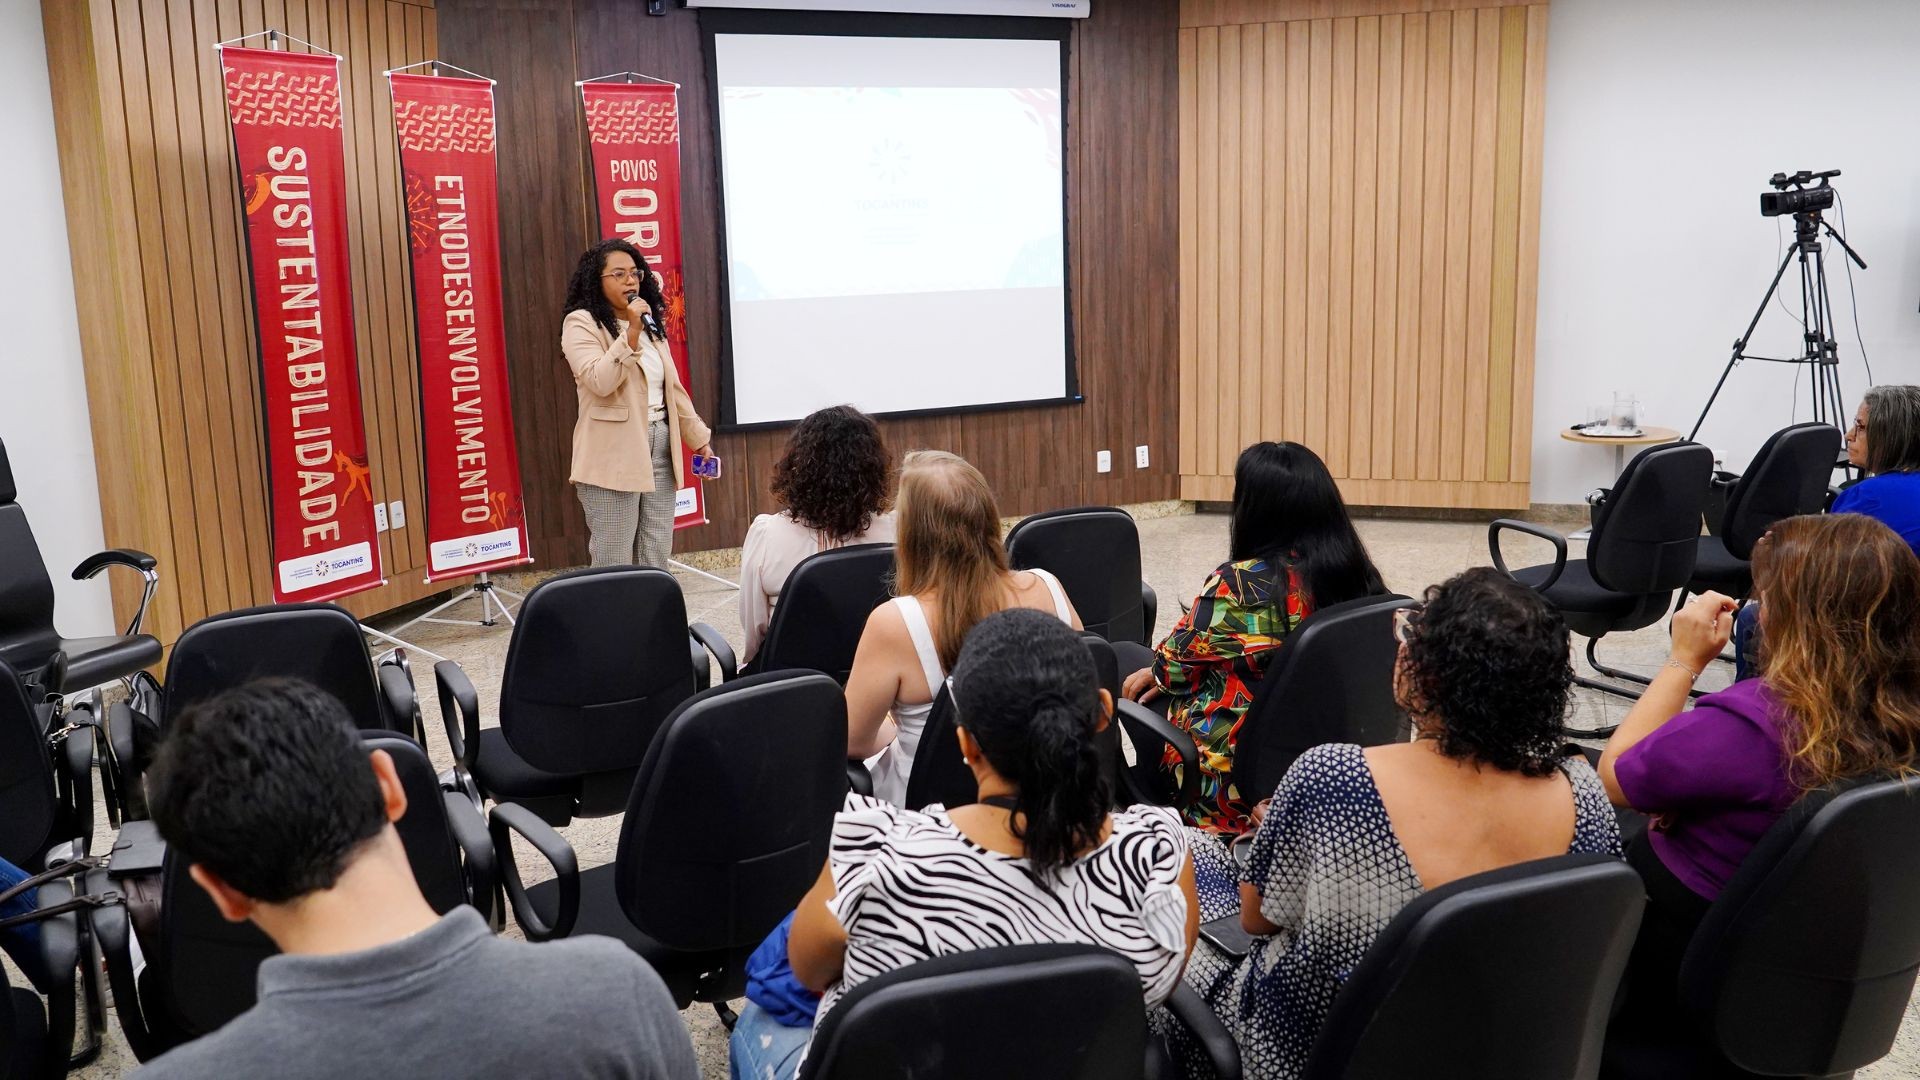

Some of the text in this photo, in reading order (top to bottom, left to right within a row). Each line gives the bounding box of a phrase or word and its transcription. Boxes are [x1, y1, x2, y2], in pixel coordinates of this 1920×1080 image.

[610, 159, 658, 182] POVOS
[267, 146, 340, 548] SUSTENTABILIDADE
[434, 175, 490, 524] ETNODESENVOLVIMENTO
[480, 540, 512, 552] TOCANTINS
[331, 556, 363, 570] TOCANTINS
